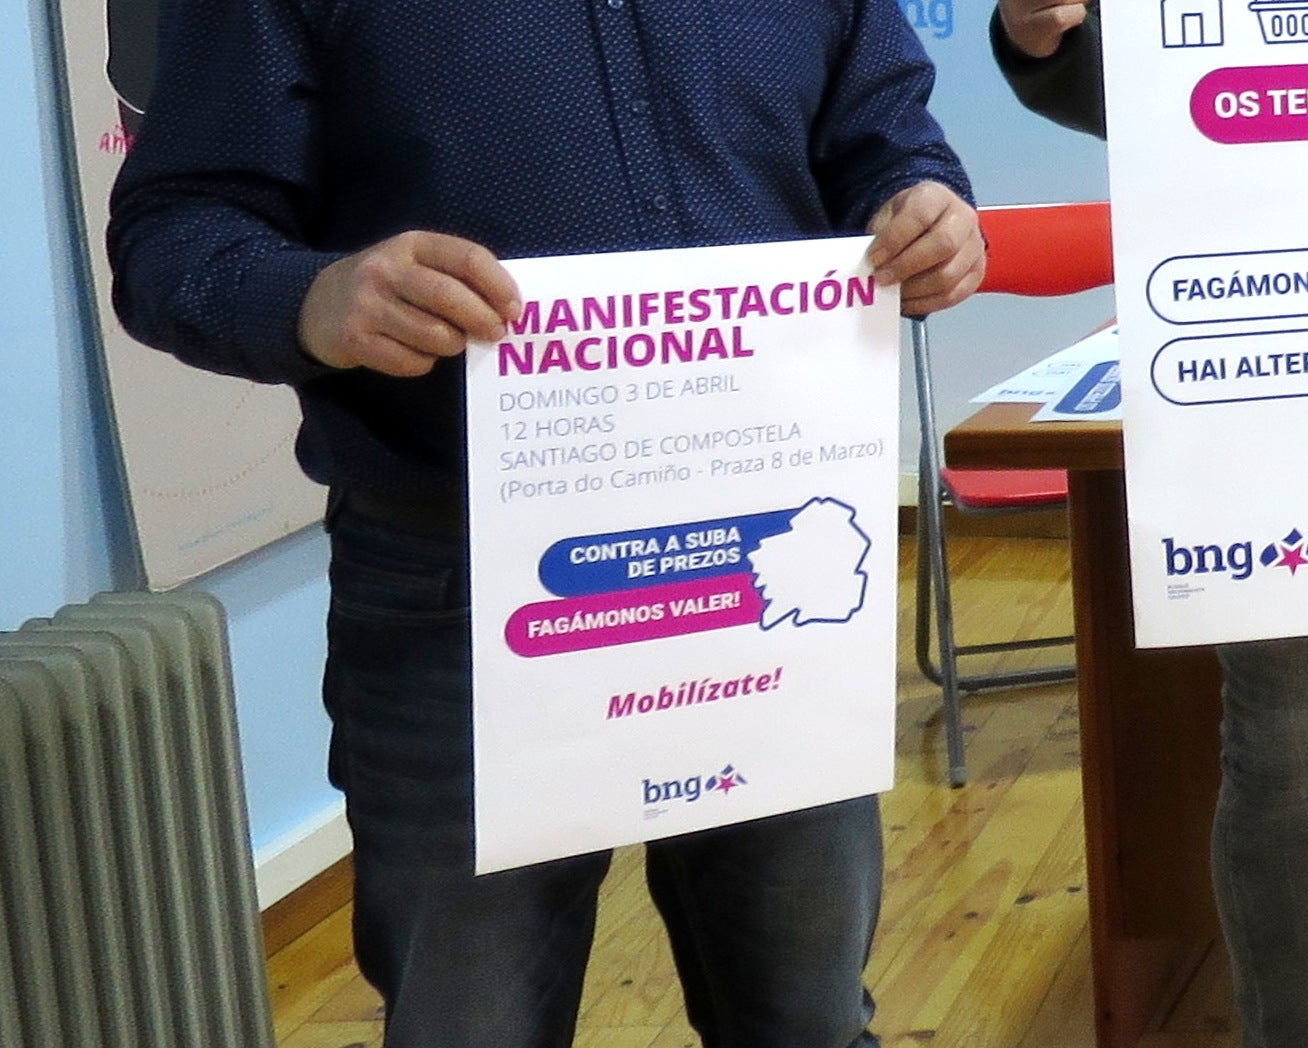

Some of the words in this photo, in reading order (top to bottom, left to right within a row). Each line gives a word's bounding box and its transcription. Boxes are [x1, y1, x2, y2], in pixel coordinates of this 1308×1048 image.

[1214, 90, 1260, 118] OS
[506, 270, 876, 336] MANIFESTACIÓN
[497, 326, 755, 378] NACIONAL
[1177, 359, 1226, 383] HAI
[499, 385, 619, 412] DOMINGO
[626, 384, 638, 402] 3
[646, 380, 674, 399] DE
[681, 374, 740, 396] ABRIL
[499, 445, 623, 472] SANTIAGO
[629, 438, 653, 458] DE
[660, 421, 802, 455] COMPOSTELA
[500, 422, 527, 441] 12
[536, 415, 615, 438] HORAS
[499, 481, 568, 504] (Porta
[574, 476, 603, 495] do
[610, 462, 691, 489] Camiño
[710, 453, 766, 478] Praza
[771, 452, 783, 470] 8
[789, 447, 814, 466] de
[819, 438, 884, 462] Marzo)
[570, 536, 658, 564] CONTRA
[664, 536, 682, 552] A
[686, 527, 741, 550] SUBA
[627, 559, 655, 580] DE
[659, 546, 741, 575] PREZOS
[1161, 537, 1253, 580] bng
[527, 601, 665, 639] FAGÁMONOS
[669, 590, 741, 619] VALER!
[606, 667, 784, 720] Mobilízate!
[642, 775, 702, 804] bng
